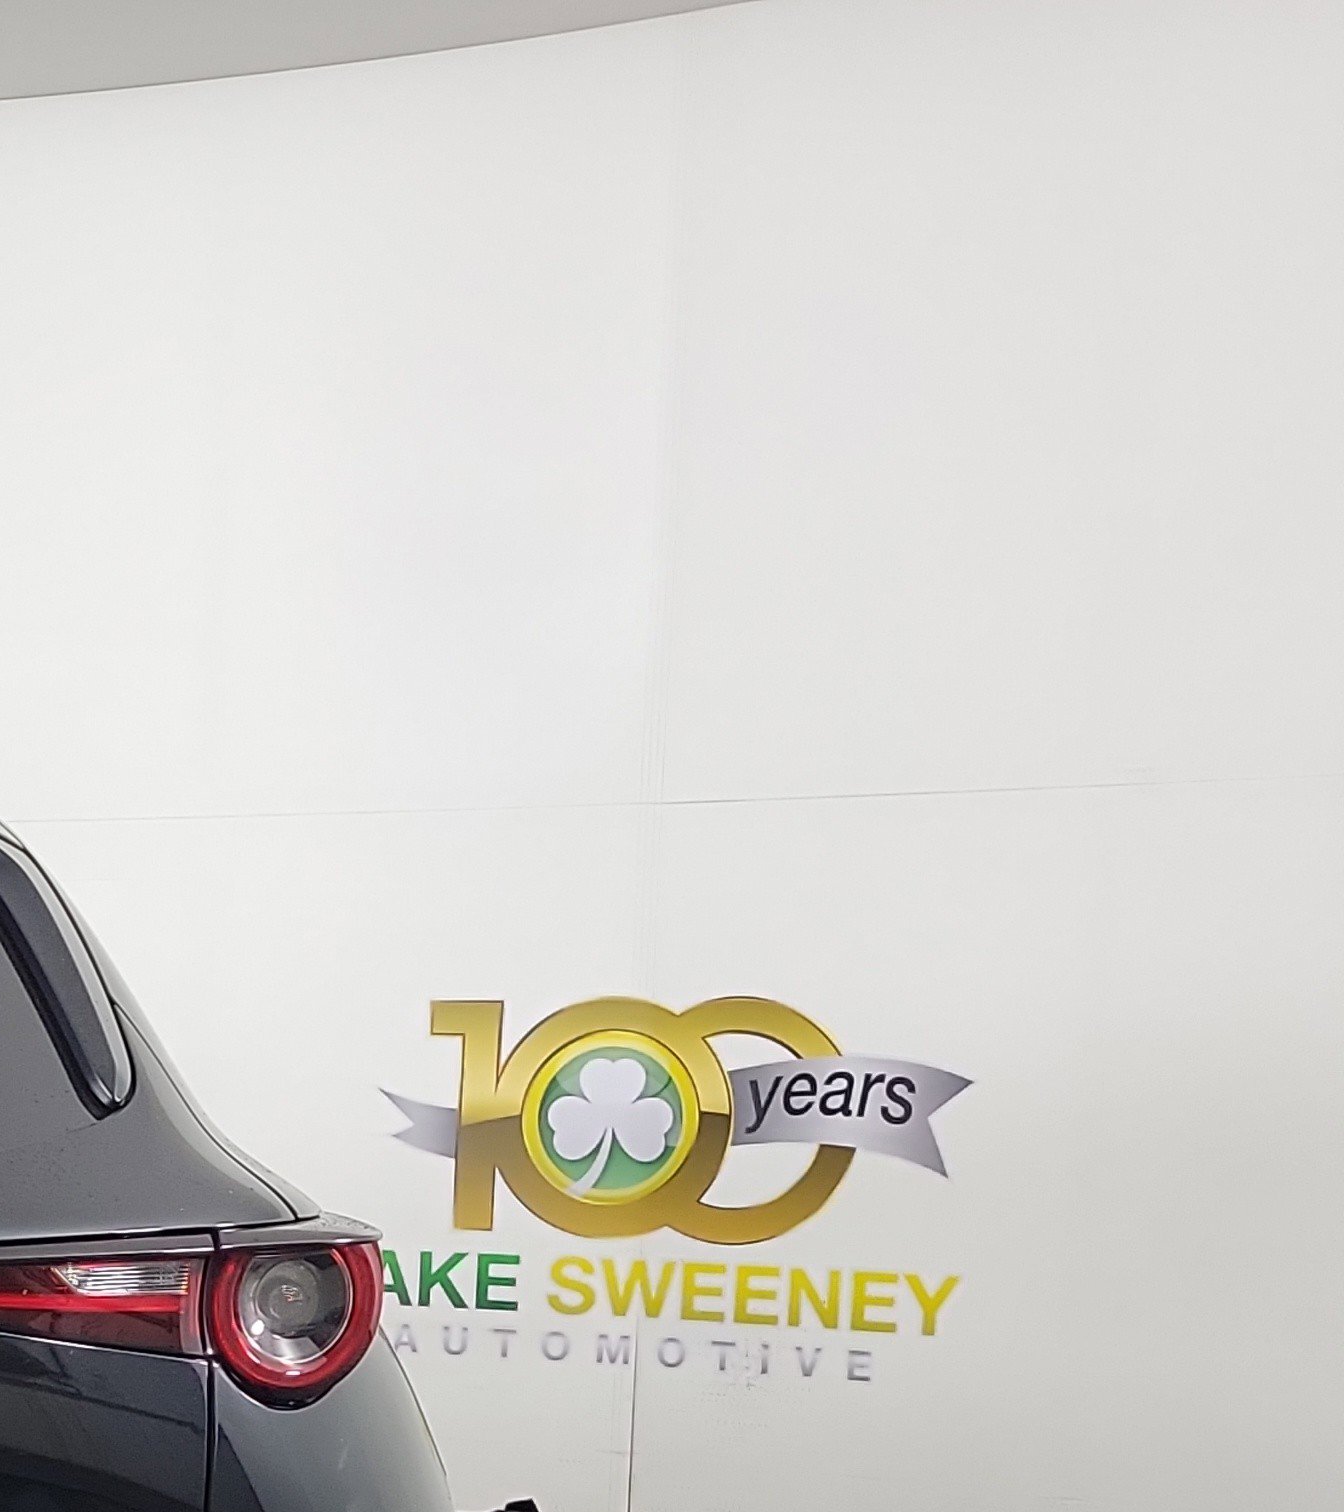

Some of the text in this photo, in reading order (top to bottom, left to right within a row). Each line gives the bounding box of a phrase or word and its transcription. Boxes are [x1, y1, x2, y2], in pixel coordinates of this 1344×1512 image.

[429, 995, 917, 1246] 100 years
[382, 1250, 960, 1337] AKE SWEENEY
[394, 1323, 872, 1383] AUTOMOTIVE
